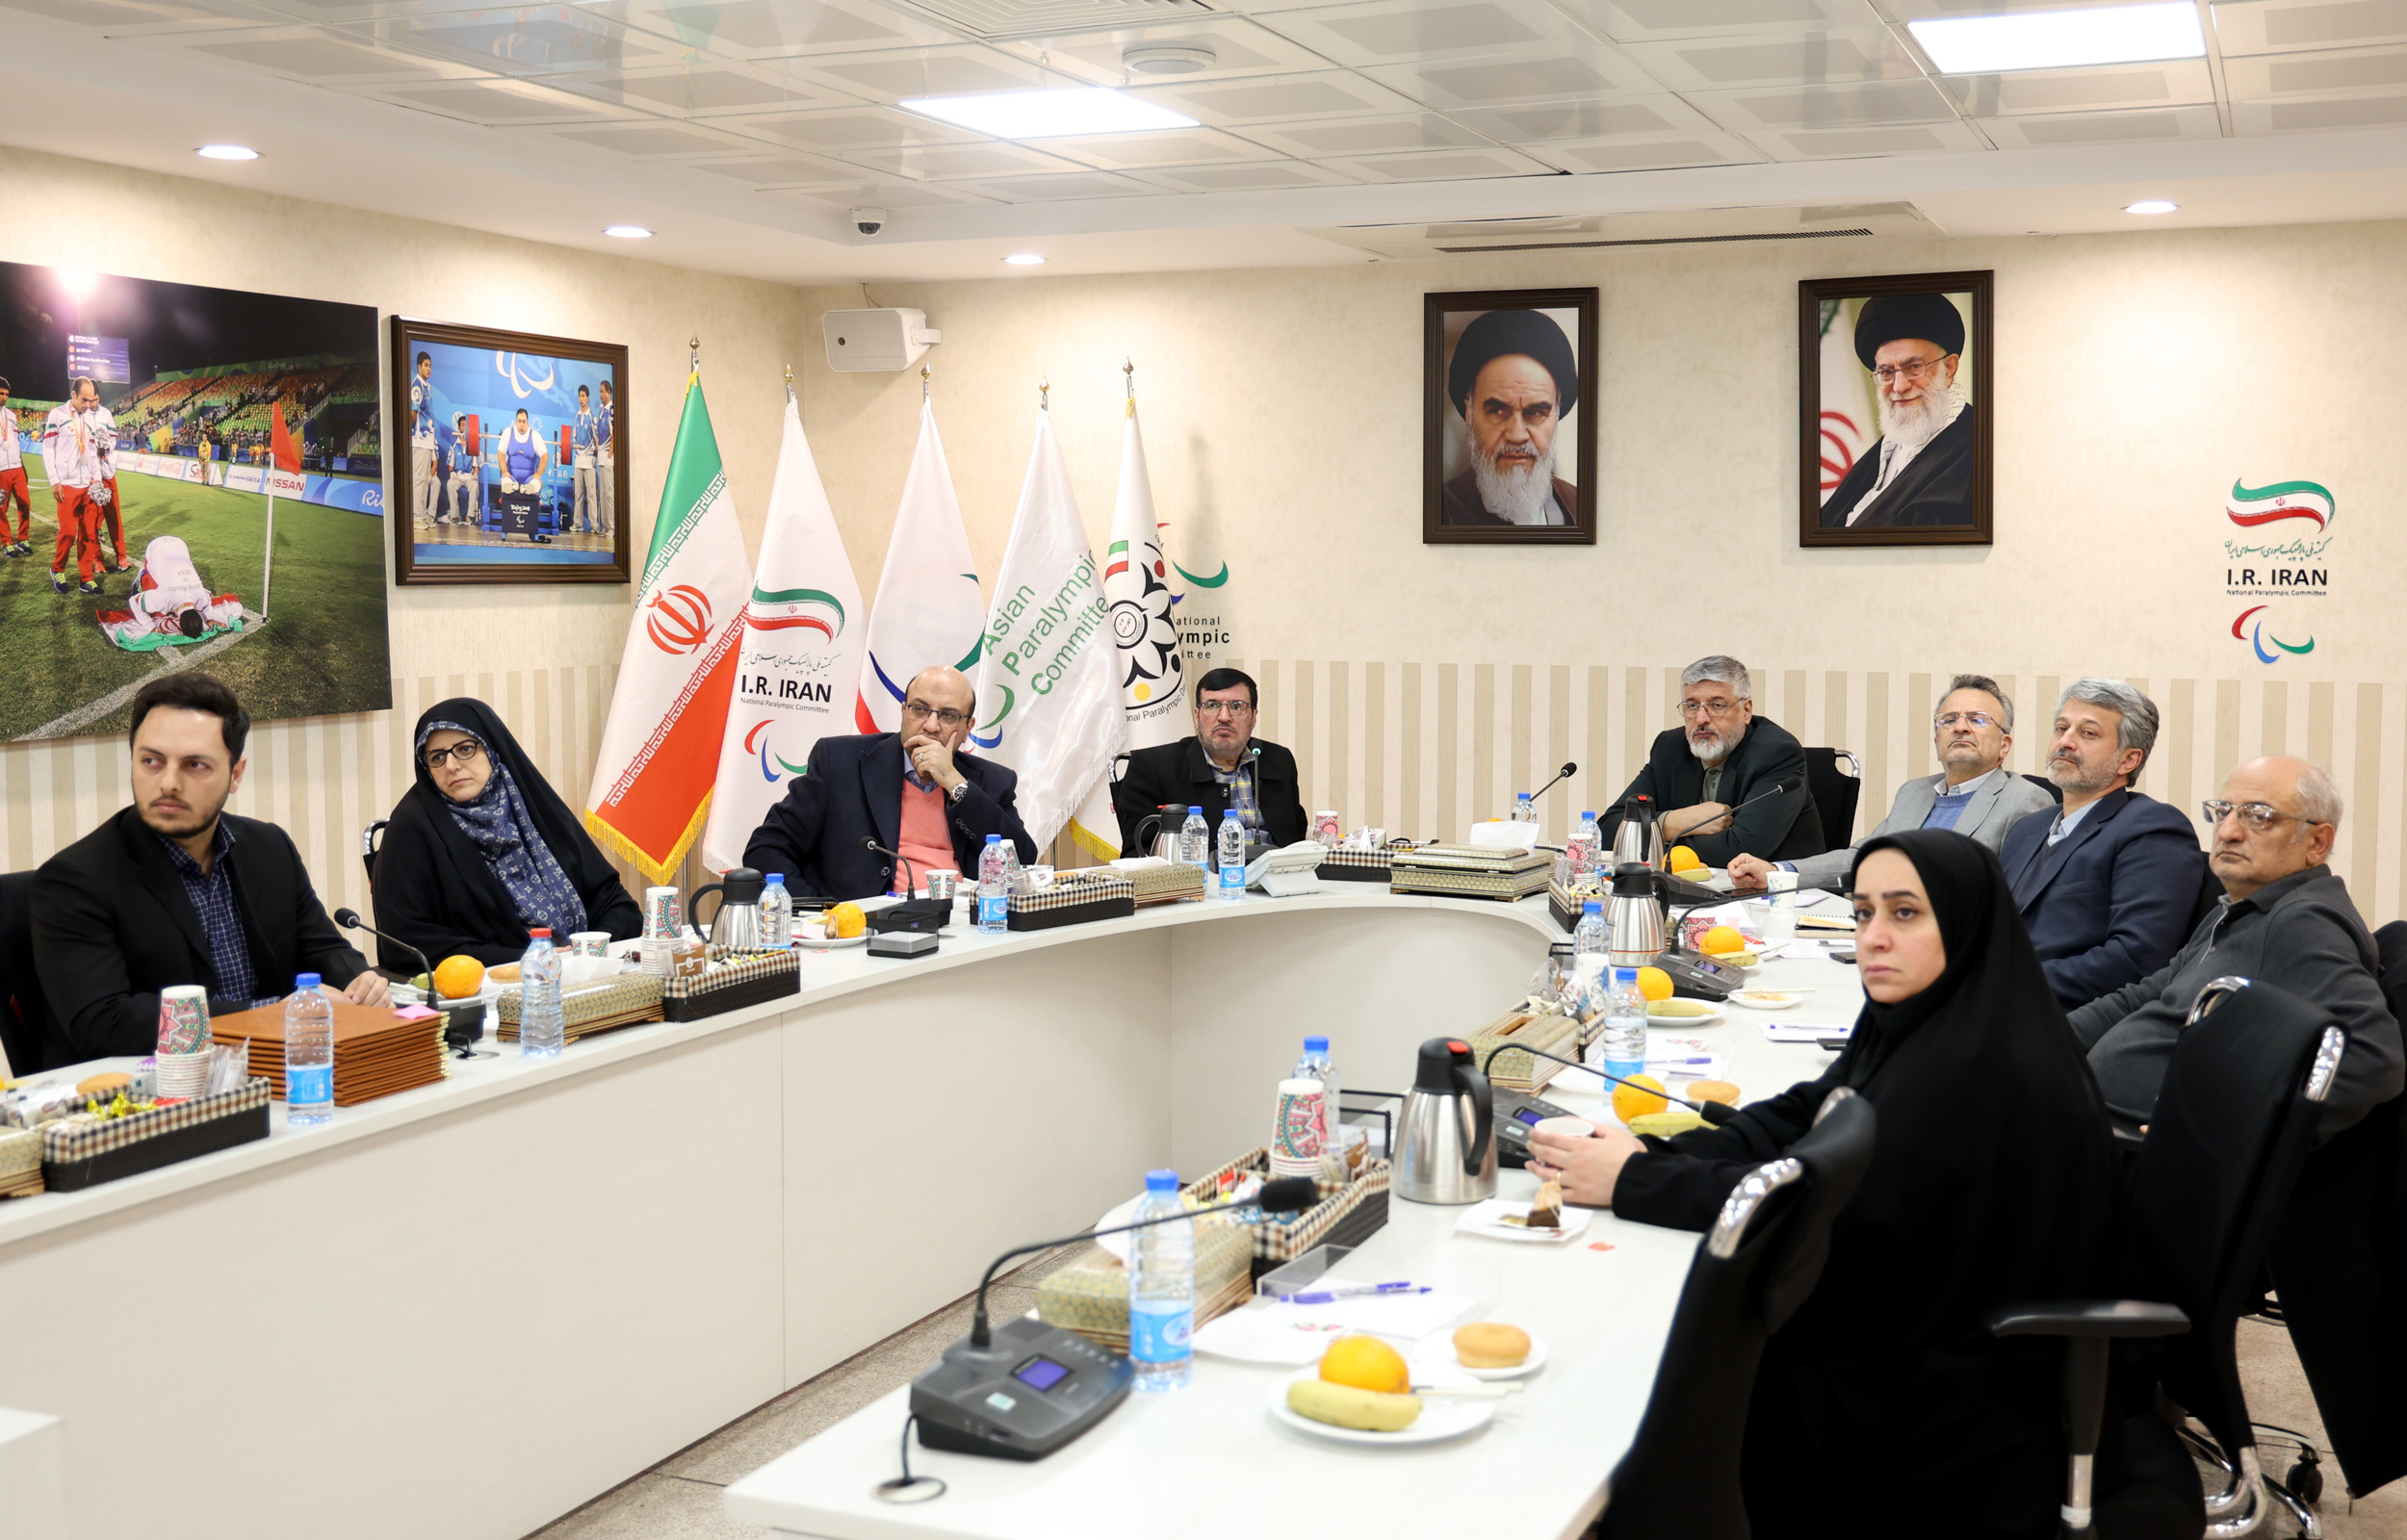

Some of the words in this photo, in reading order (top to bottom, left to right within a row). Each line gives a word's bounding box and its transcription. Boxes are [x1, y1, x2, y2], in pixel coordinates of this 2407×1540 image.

[2227, 569, 2263, 586] I.R.
[2270, 569, 2328, 586] IRAN
[2255, 589, 2290, 598] Paralympic
[982, 585, 1036, 656] Asian
[1001, 550, 1096, 677] Paralympic
[1176, 616, 1221, 626] ational
[1031, 597, 1109, 695] Committe
[1177, 629, 1229, 647] ympic
[1181, 650, 1211, 659] ittee
[741, 675, 772, 696] I.R.
[779, 679, 832, 703] IRAN
[739, 697, 765, 706] National
[765, 700, 794, 710] Paralympic
[795, 704, 830, 714] Committee
[1143, 694, 1182, 719] Paralympic
